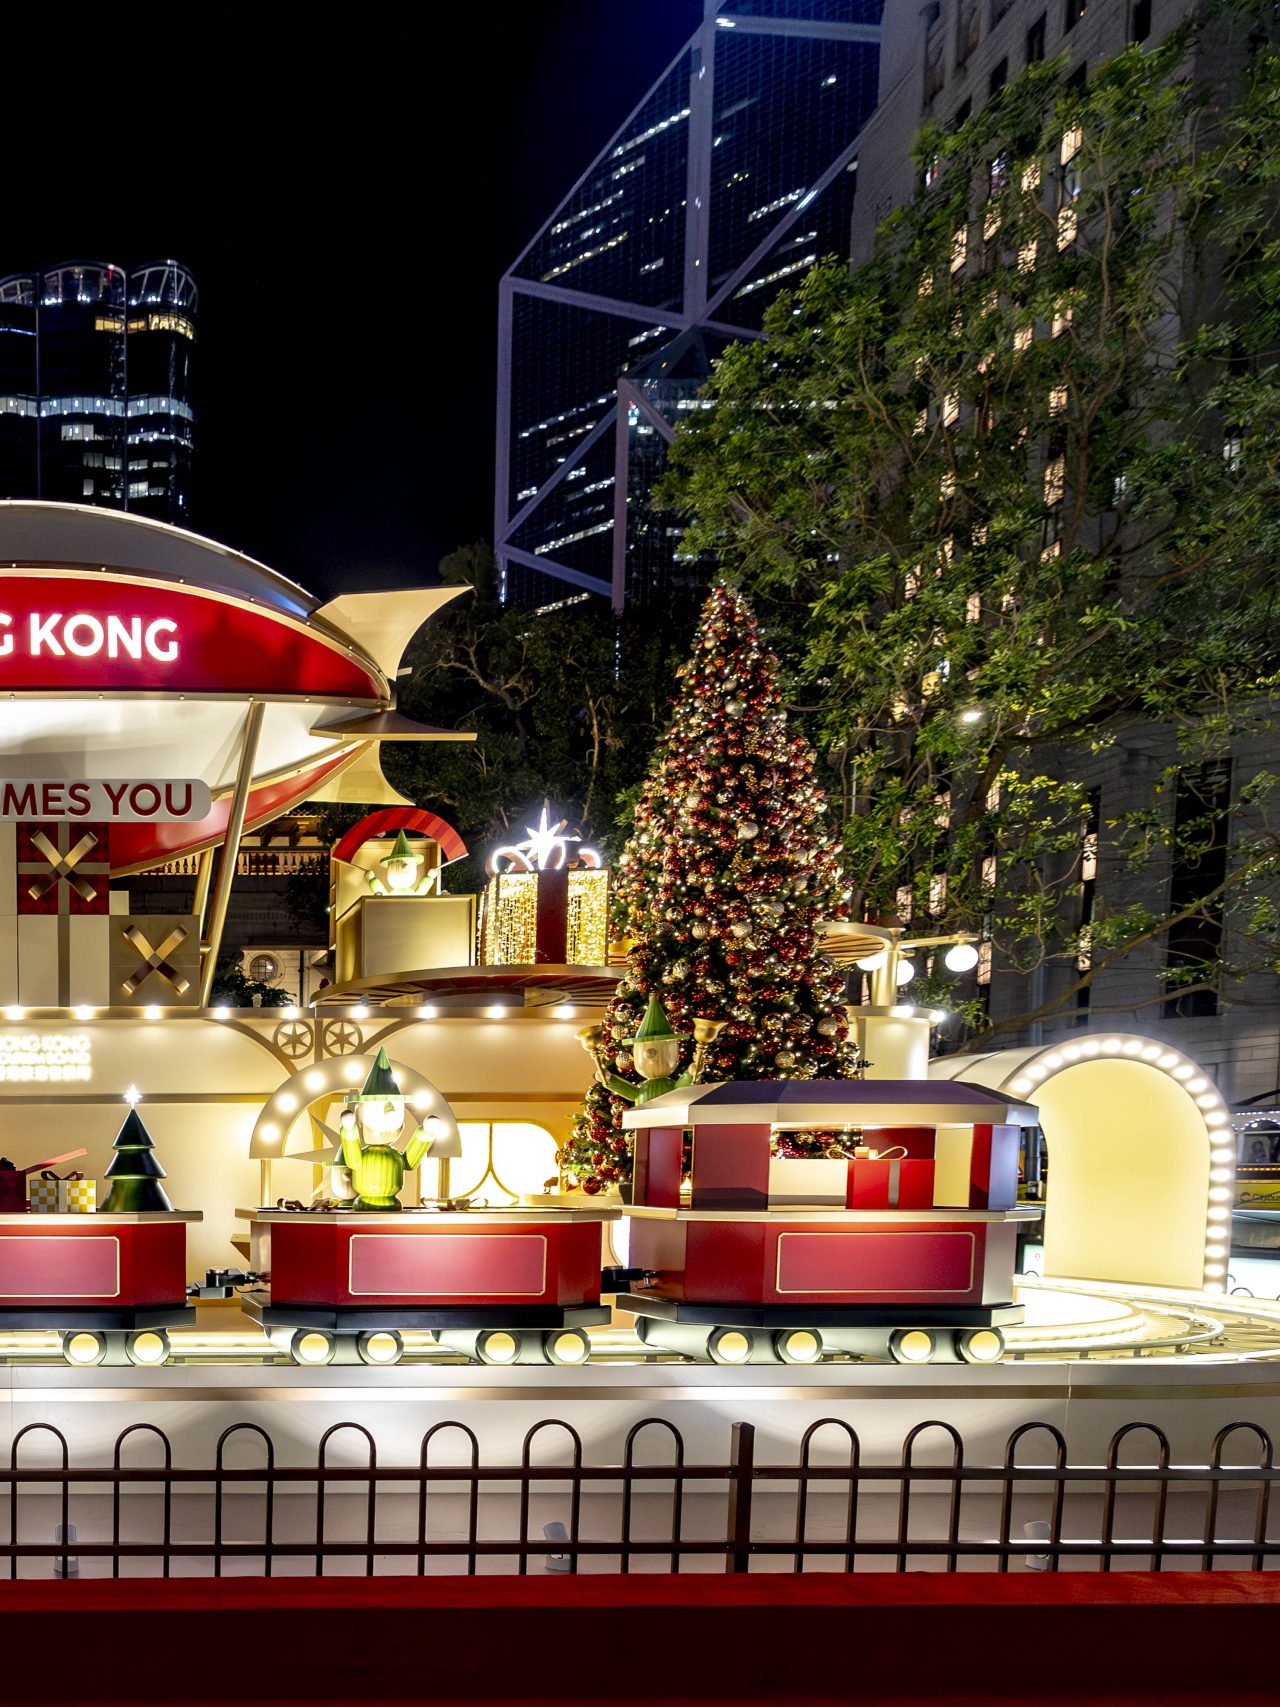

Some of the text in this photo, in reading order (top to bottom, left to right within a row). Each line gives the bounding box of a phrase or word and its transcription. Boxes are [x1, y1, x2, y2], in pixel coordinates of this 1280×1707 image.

[29, 612, 180, 662] KONG
[99, 783, 193, 816] YOU
[42, 1035, 92, 1052] KONG
